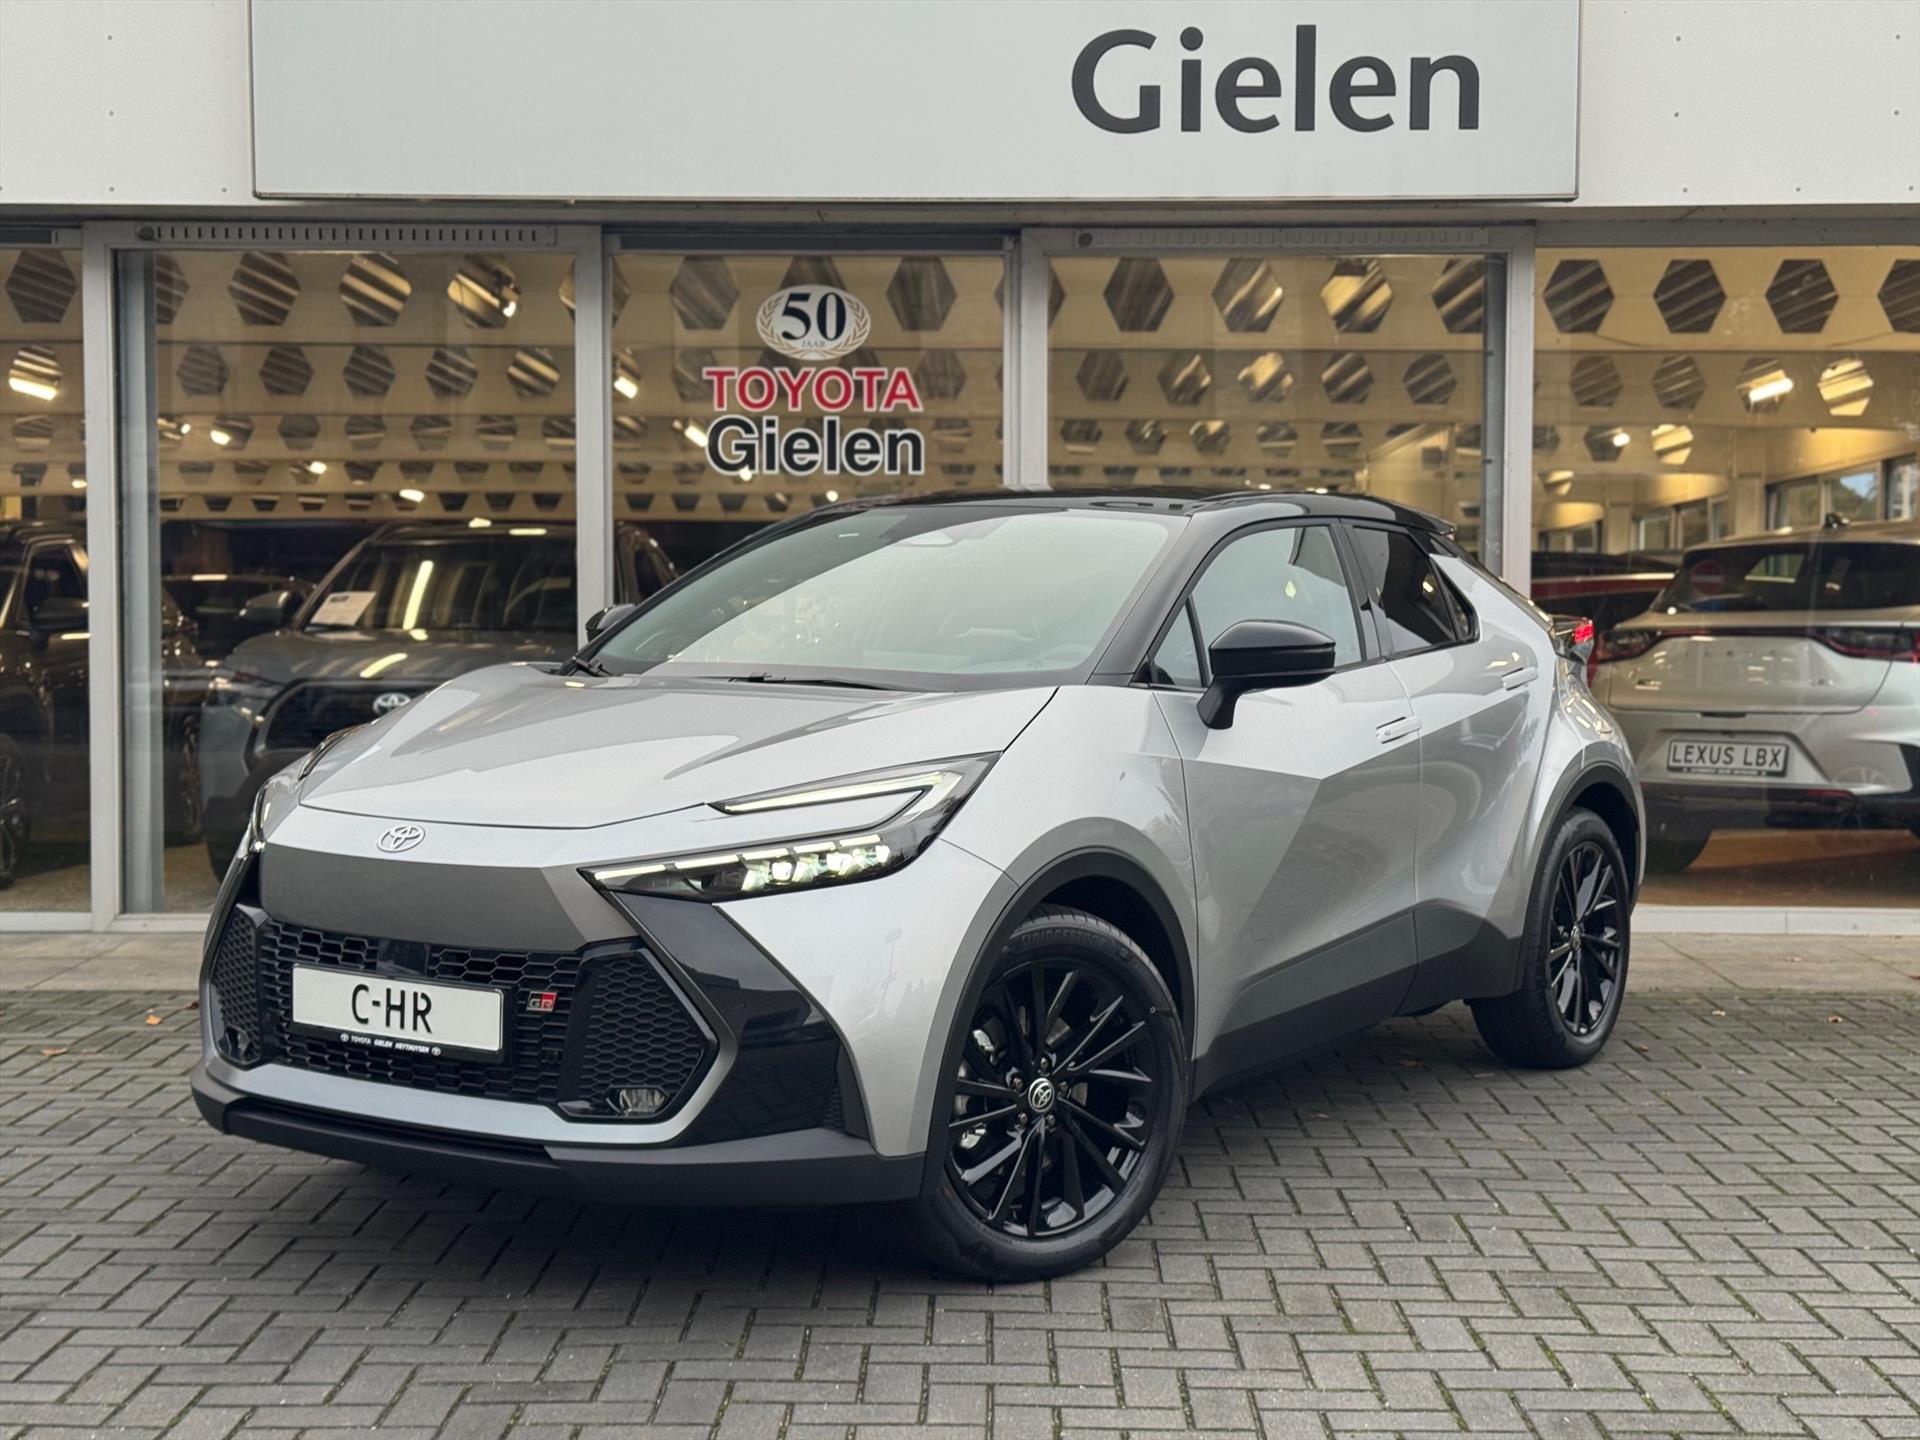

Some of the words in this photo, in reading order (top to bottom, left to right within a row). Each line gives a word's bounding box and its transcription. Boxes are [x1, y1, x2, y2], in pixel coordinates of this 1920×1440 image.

[1072, 24, 1480, 134] Gielen
[781, 292, 847, 341] 50
[801, 340, 826, 348] JAAR
[703, 367, 923, 411] TOYOTA
[706, 415, 925, 475] Gielen
[1672, 744, 1734, 765] LEXUS
[1743, 747, 1782, 768] LBX
[351, 983, 432, 1034] C-HR
[351, 1035, 372, 1045] TOYOTA
[374, 1039, 393, 1048] GIELEN
